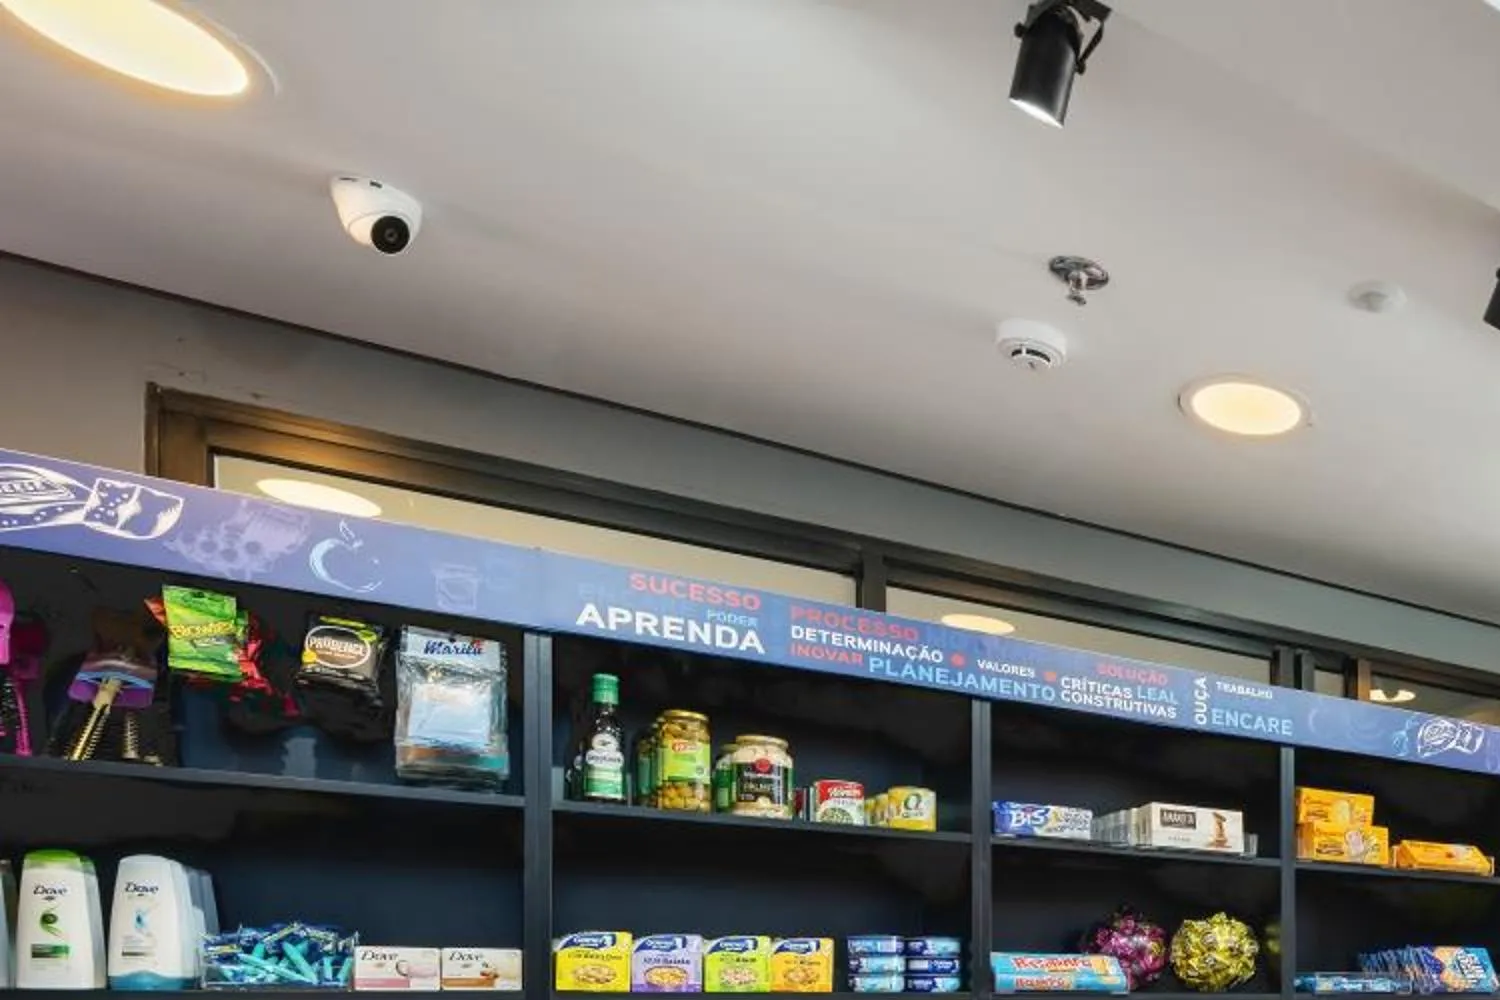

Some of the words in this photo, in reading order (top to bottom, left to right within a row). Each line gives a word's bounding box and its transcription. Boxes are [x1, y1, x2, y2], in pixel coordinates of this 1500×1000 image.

[629, 571, 761, 612] SUCESSO
[575, 603, 766, 654] APRENDA
[790, 605, 919, 641] PROCESSO
[790, 642, 864, 667] INOVAR
[791, 625, 944, 663] DETERMINAÇÃO
[869, 656, 1056, 702] PLANEJAMENTO
[977, 658, 1036, 680] VALORES
[1099, 663, 1168, 687] SOLUÇÃO
[1061, 674, 1133, 700] CRÍTICAS
[1136, 686, 1178, 705] LEAL
[1194, 675, 1211, 725] OUÇA
[1216, 680, 1273, 700] TRABALHO
[1060, 689, 1177, 720] CONSTRUTIVAS
[1211, 707, 1294, 737] ENCARE
[33, 884, 67, 896] Dove
[125, 881, 159, 893] Dove
[361, 949, 399, 962] Dove
